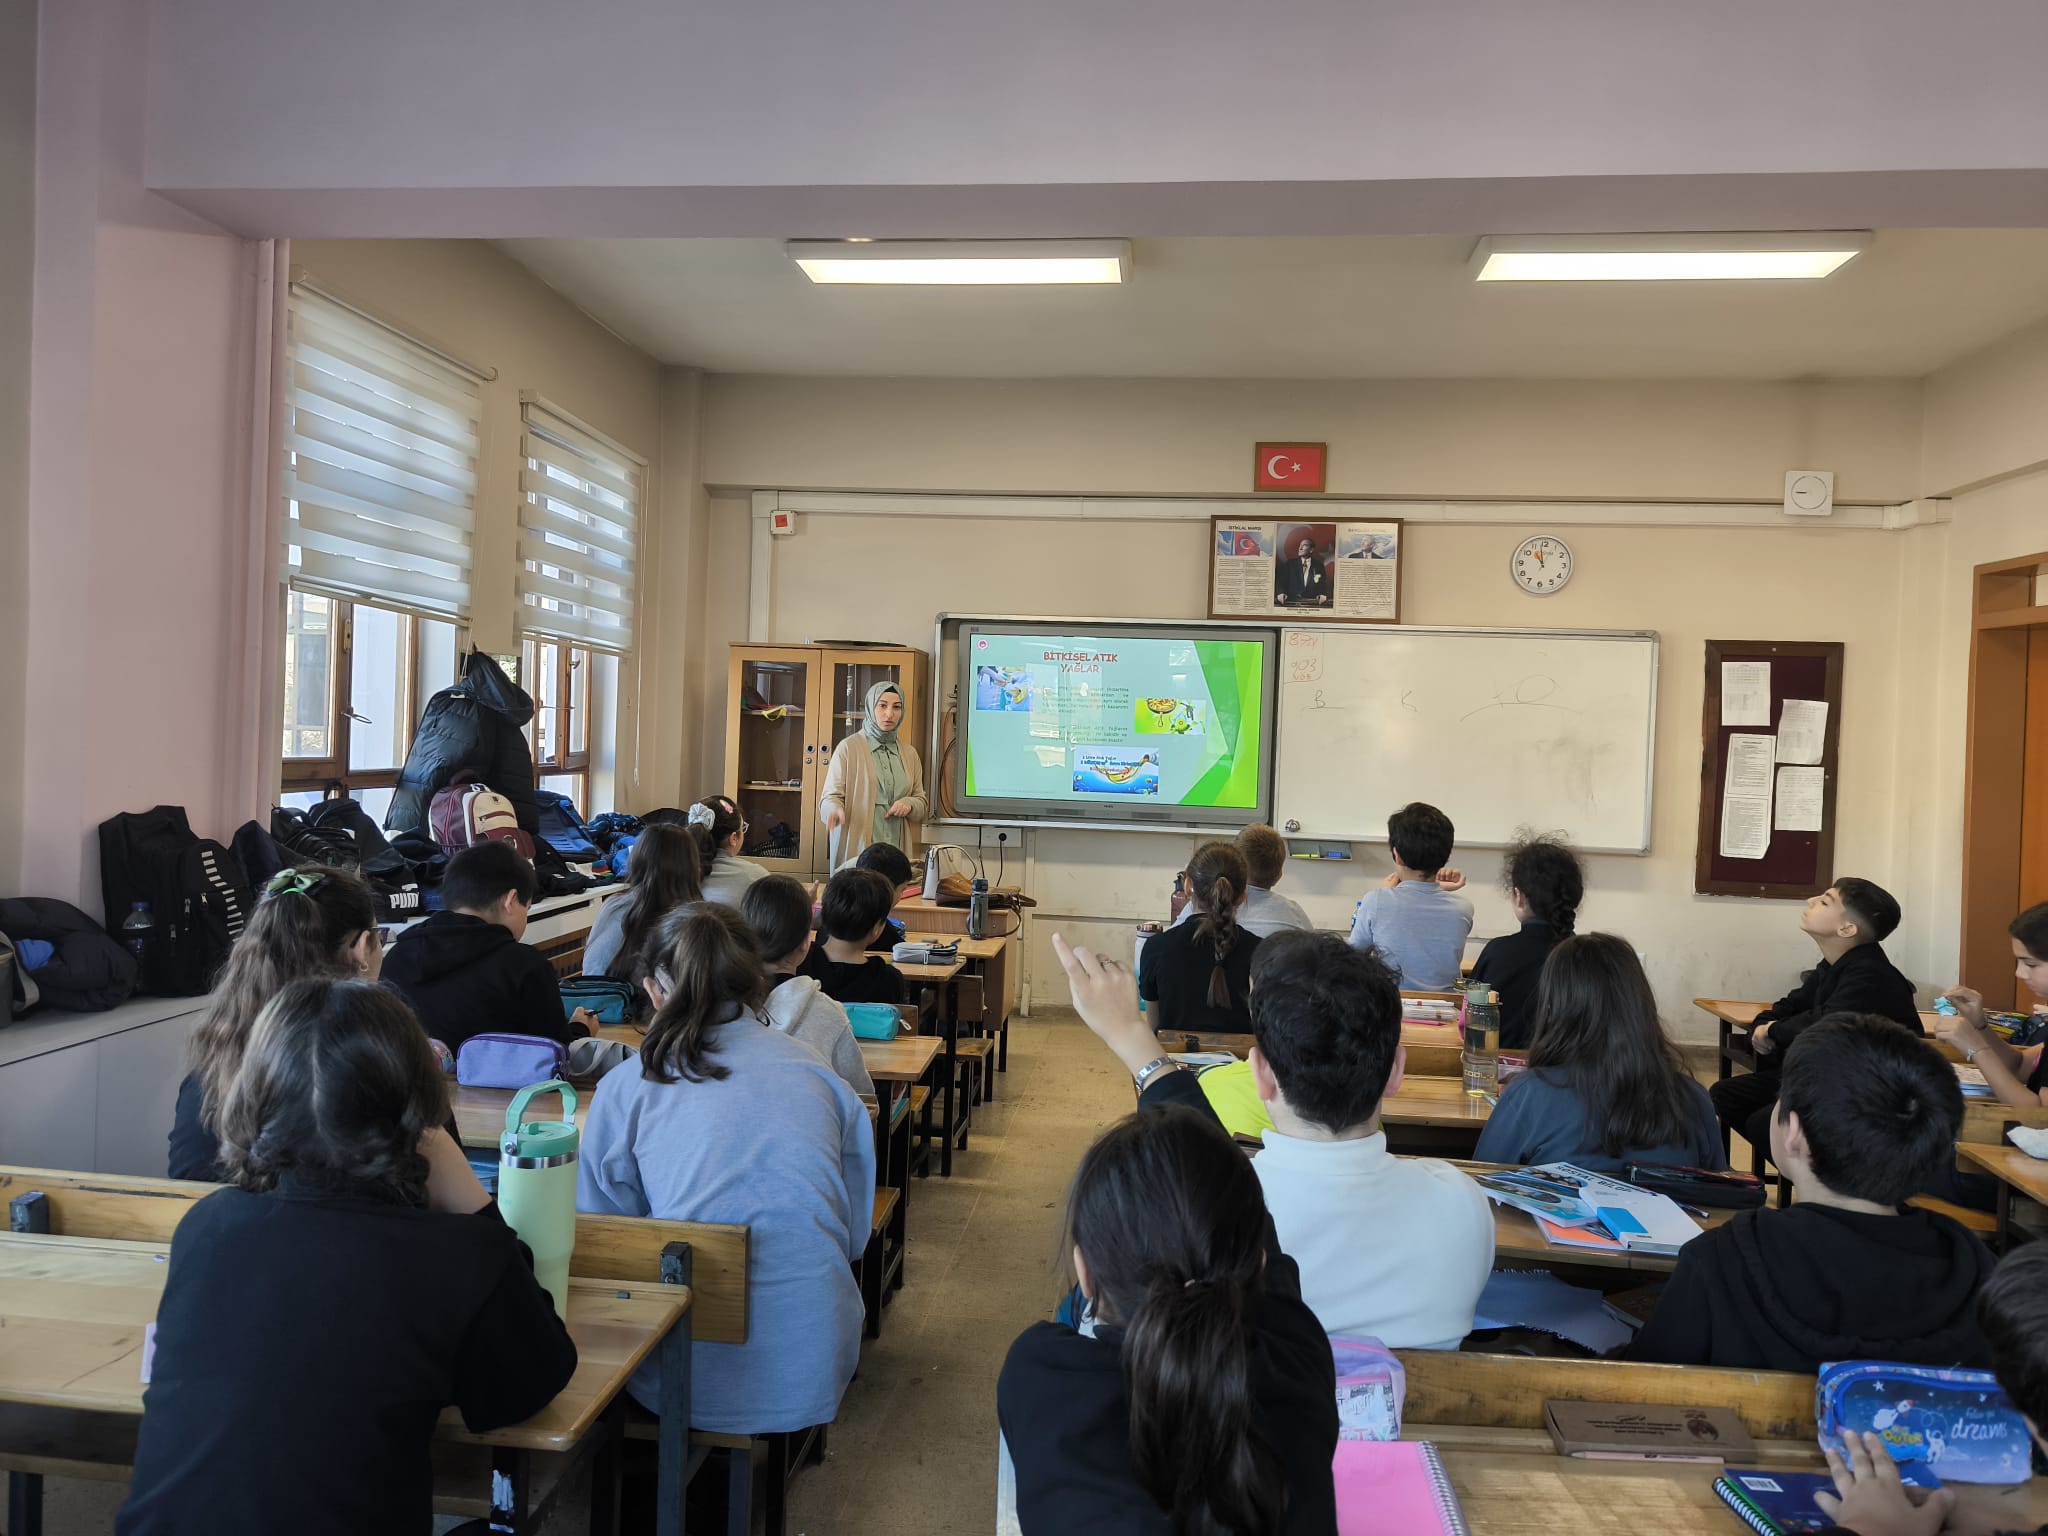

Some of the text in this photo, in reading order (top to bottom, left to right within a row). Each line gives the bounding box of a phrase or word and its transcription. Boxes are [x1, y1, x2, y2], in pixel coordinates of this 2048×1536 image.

[1043, 650, 1118, 663] BİTKİSEL ATIK
[1060, 662, 1100, 673] YAĞLAR
